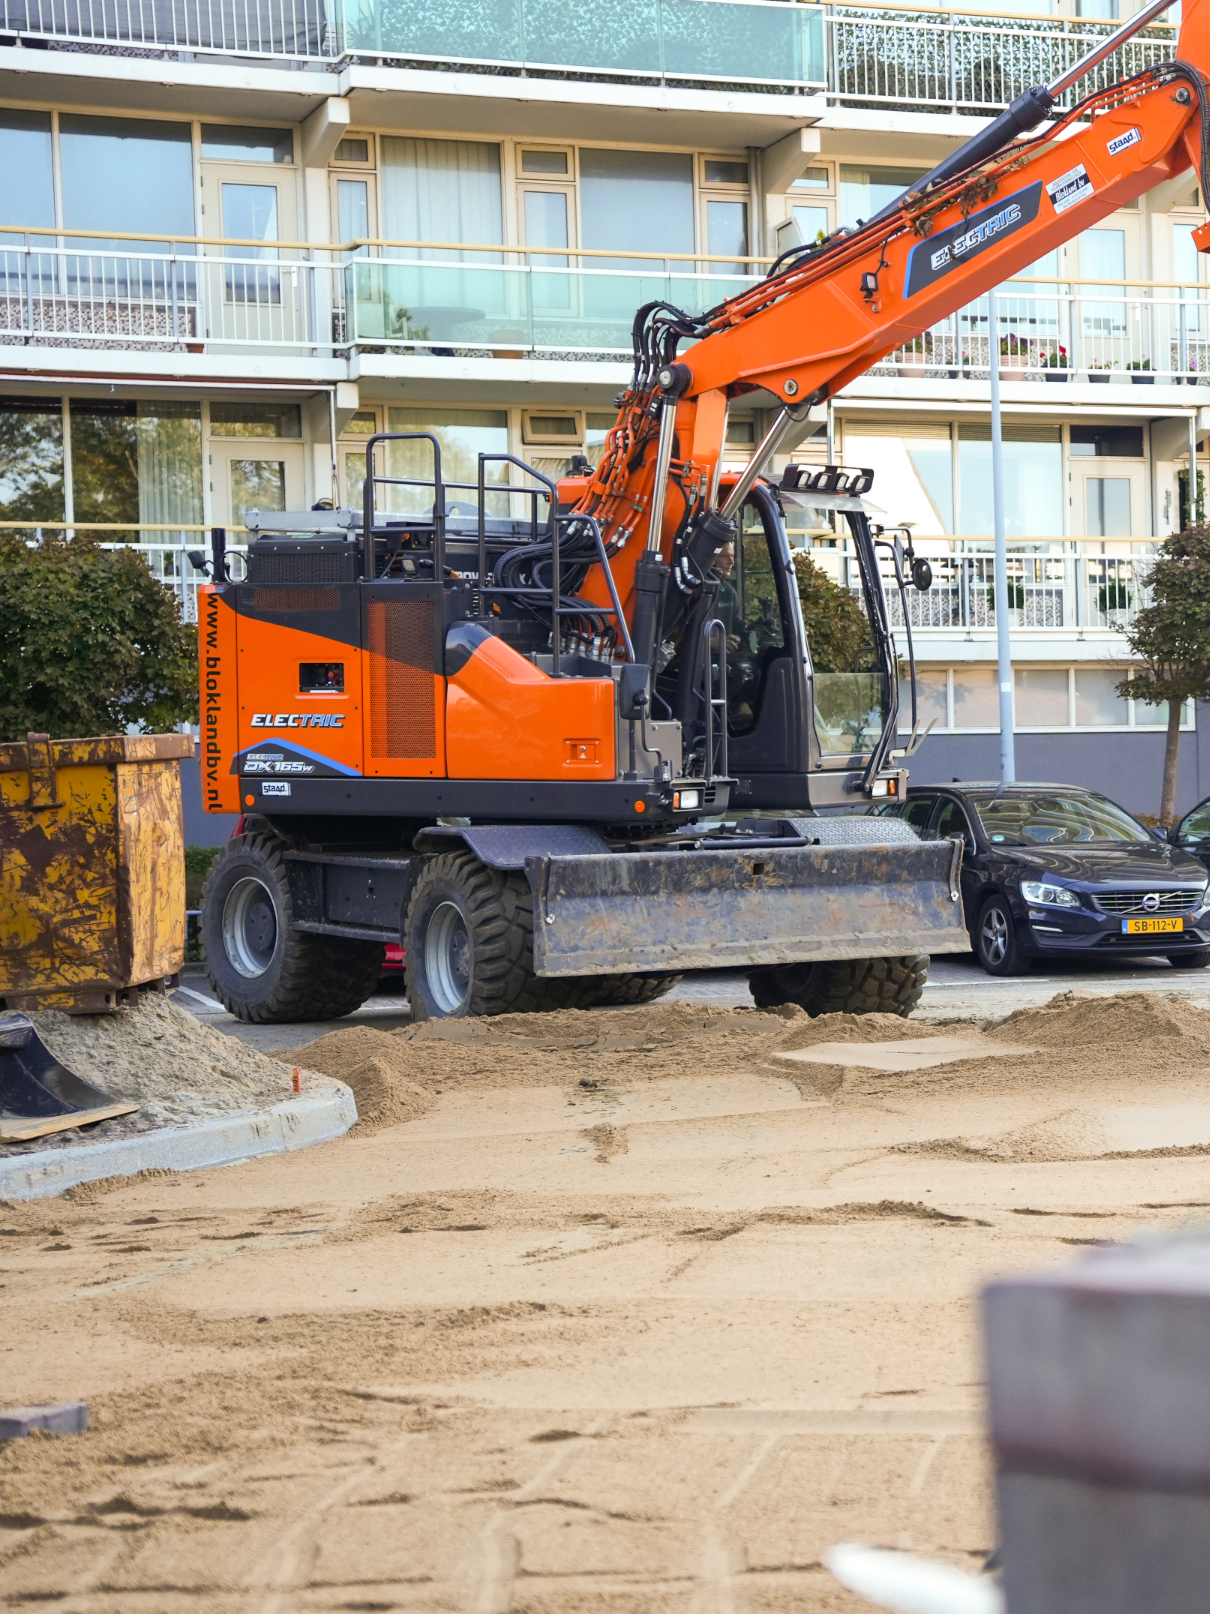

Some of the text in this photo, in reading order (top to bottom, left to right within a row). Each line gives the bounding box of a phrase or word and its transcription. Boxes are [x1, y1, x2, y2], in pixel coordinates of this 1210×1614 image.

[205, 592, 223, 811] www.bloklandbv.nl
[250, 713, 346, 728] ELECTRIC
[1134, 920, 1178, 932] SB-112-V
